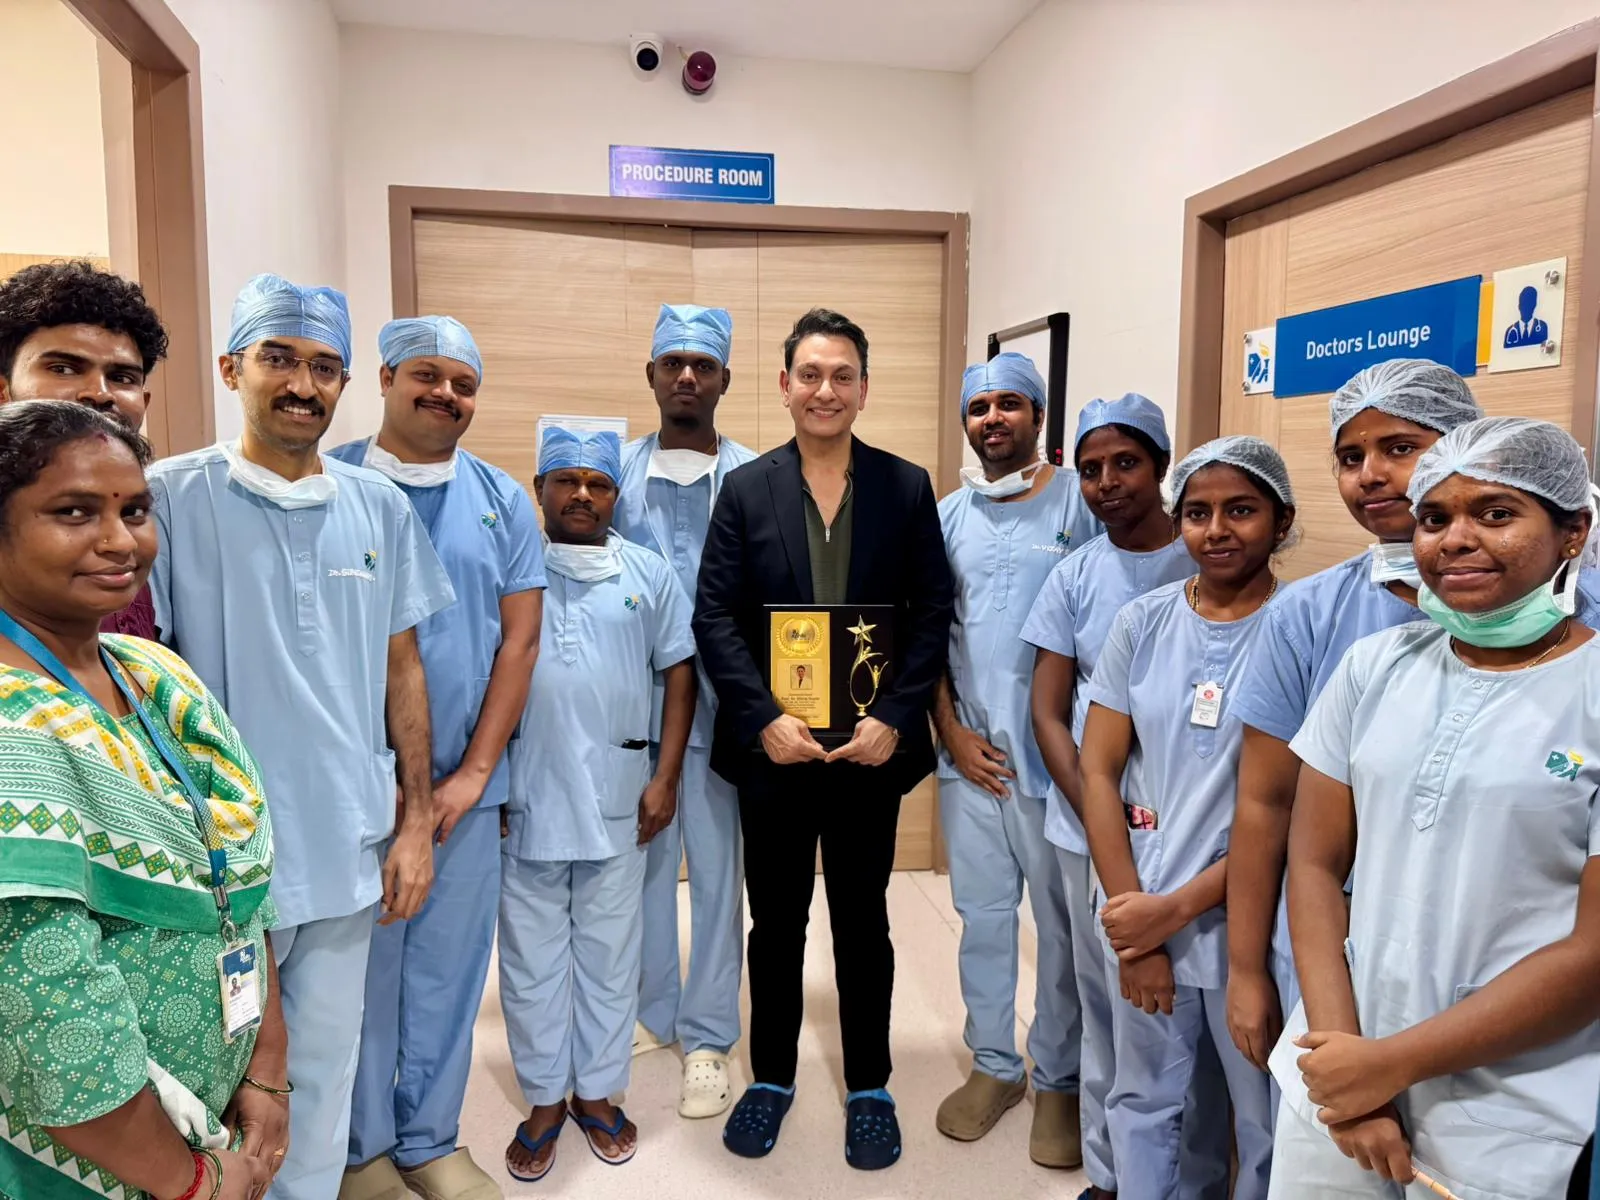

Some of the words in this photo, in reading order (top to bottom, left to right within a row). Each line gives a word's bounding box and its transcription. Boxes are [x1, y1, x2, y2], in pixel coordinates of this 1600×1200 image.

[622, 163, 714, 184] PROCEDURE
[718, 168, 763, 186] ROOM
[1306, 336, 1363, 360] Doctors
[1367, 324, 1431, 350] Lounge
